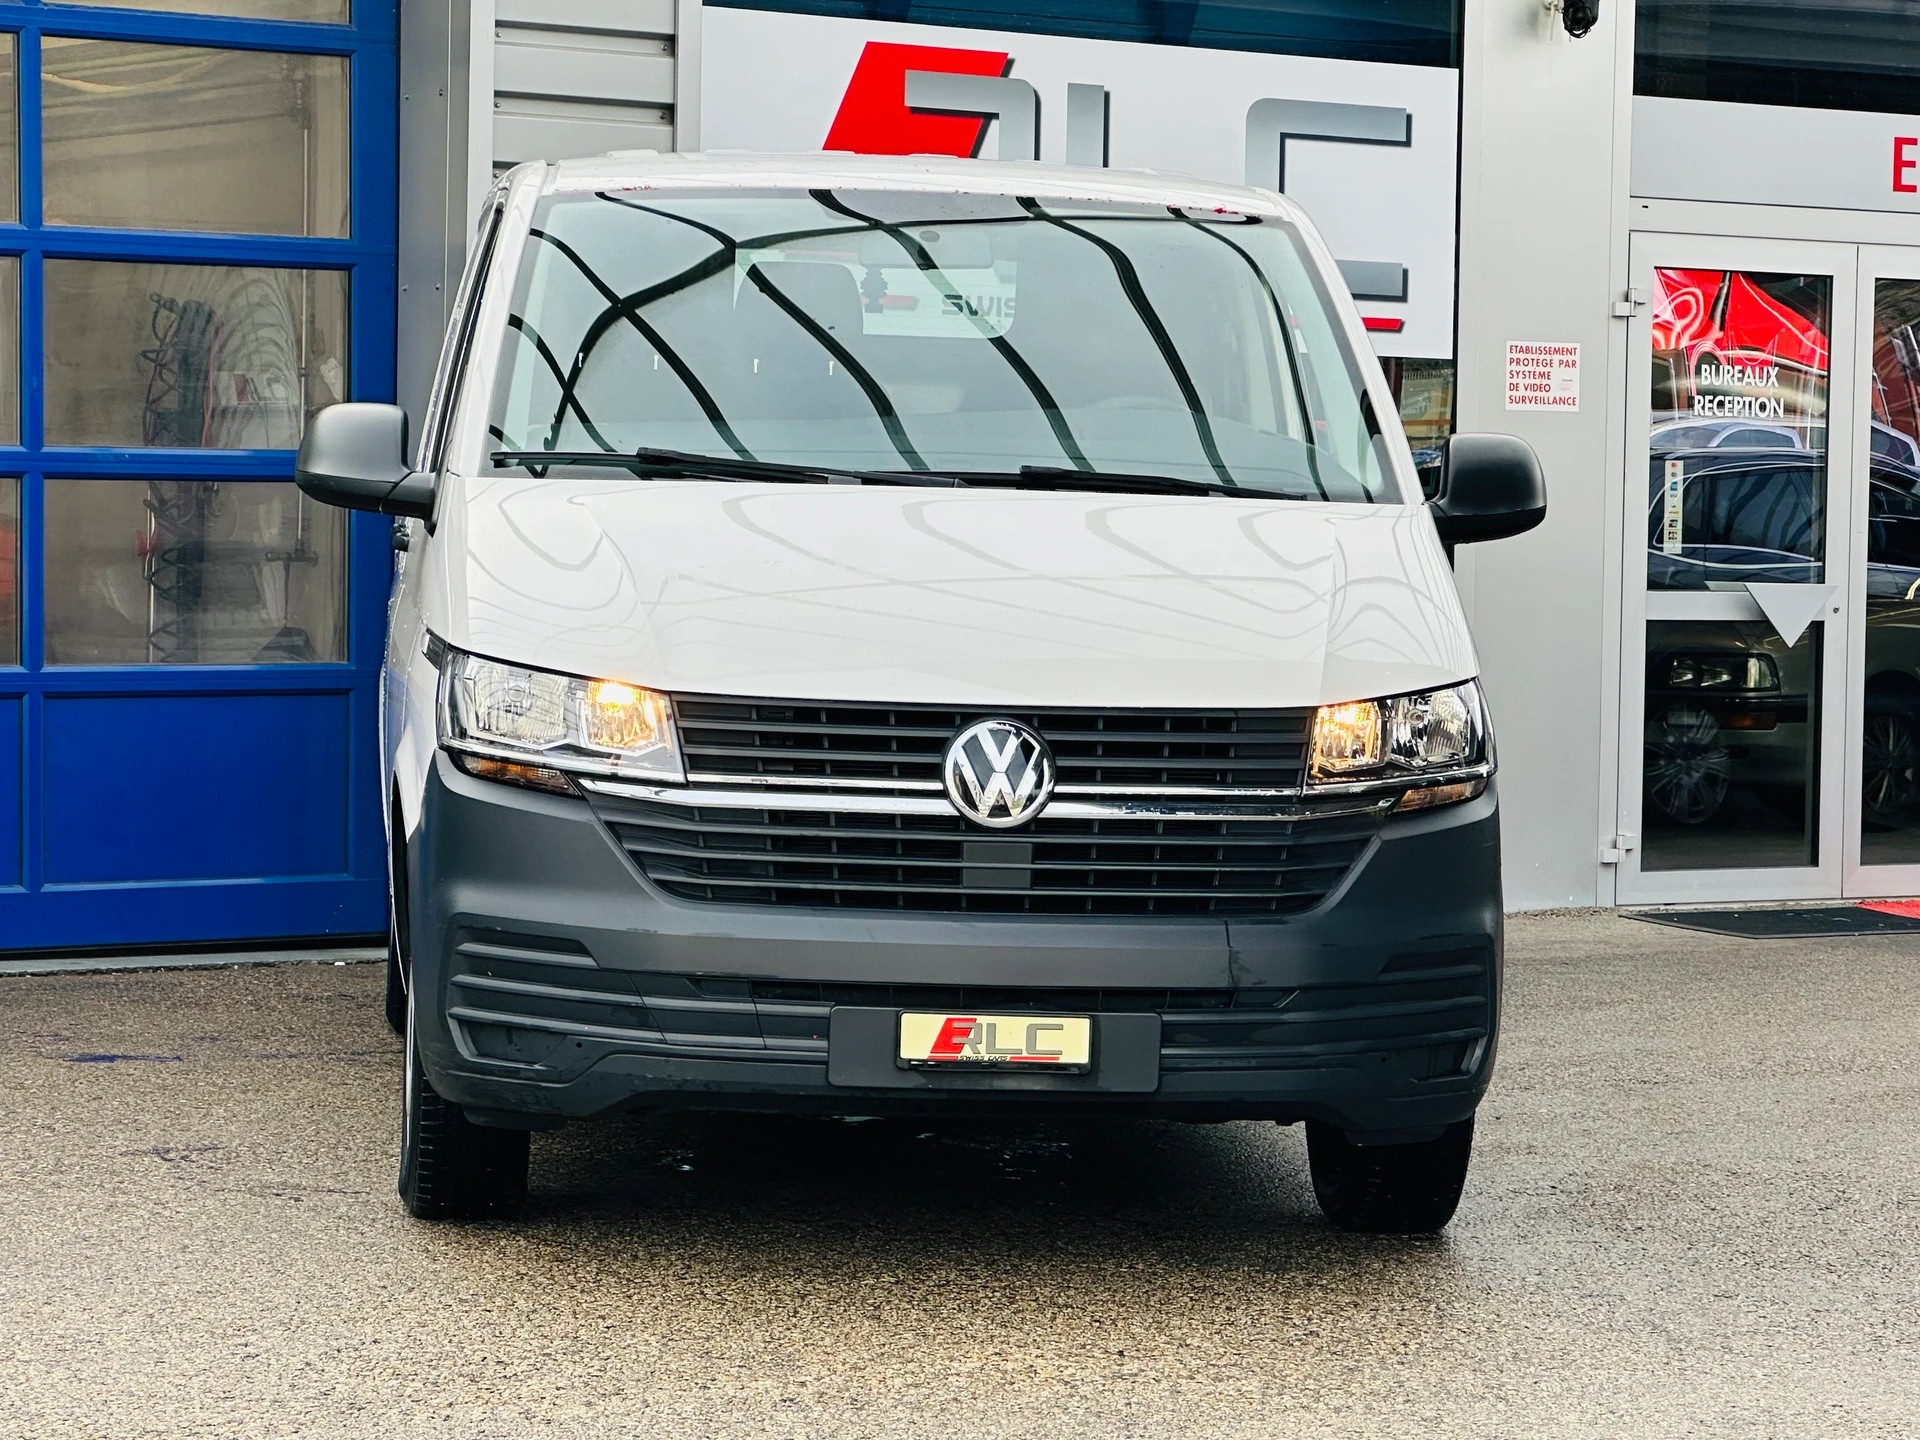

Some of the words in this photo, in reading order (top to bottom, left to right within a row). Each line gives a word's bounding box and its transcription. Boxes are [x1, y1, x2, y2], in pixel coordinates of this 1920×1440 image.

[1893, 137, 1918, 193] E
[1509, 345, 1577, 356] ETABLISSEMENT
[1558, 359, 1577, 368] PAR
[1701, 364, 1779, 387] BUREAUX
[1509, 382, 1520, 392] DE
[1508, 395, 1577, 406] SURVEILLANCE
[1694, 394, 1784, 418] RECEPTION
